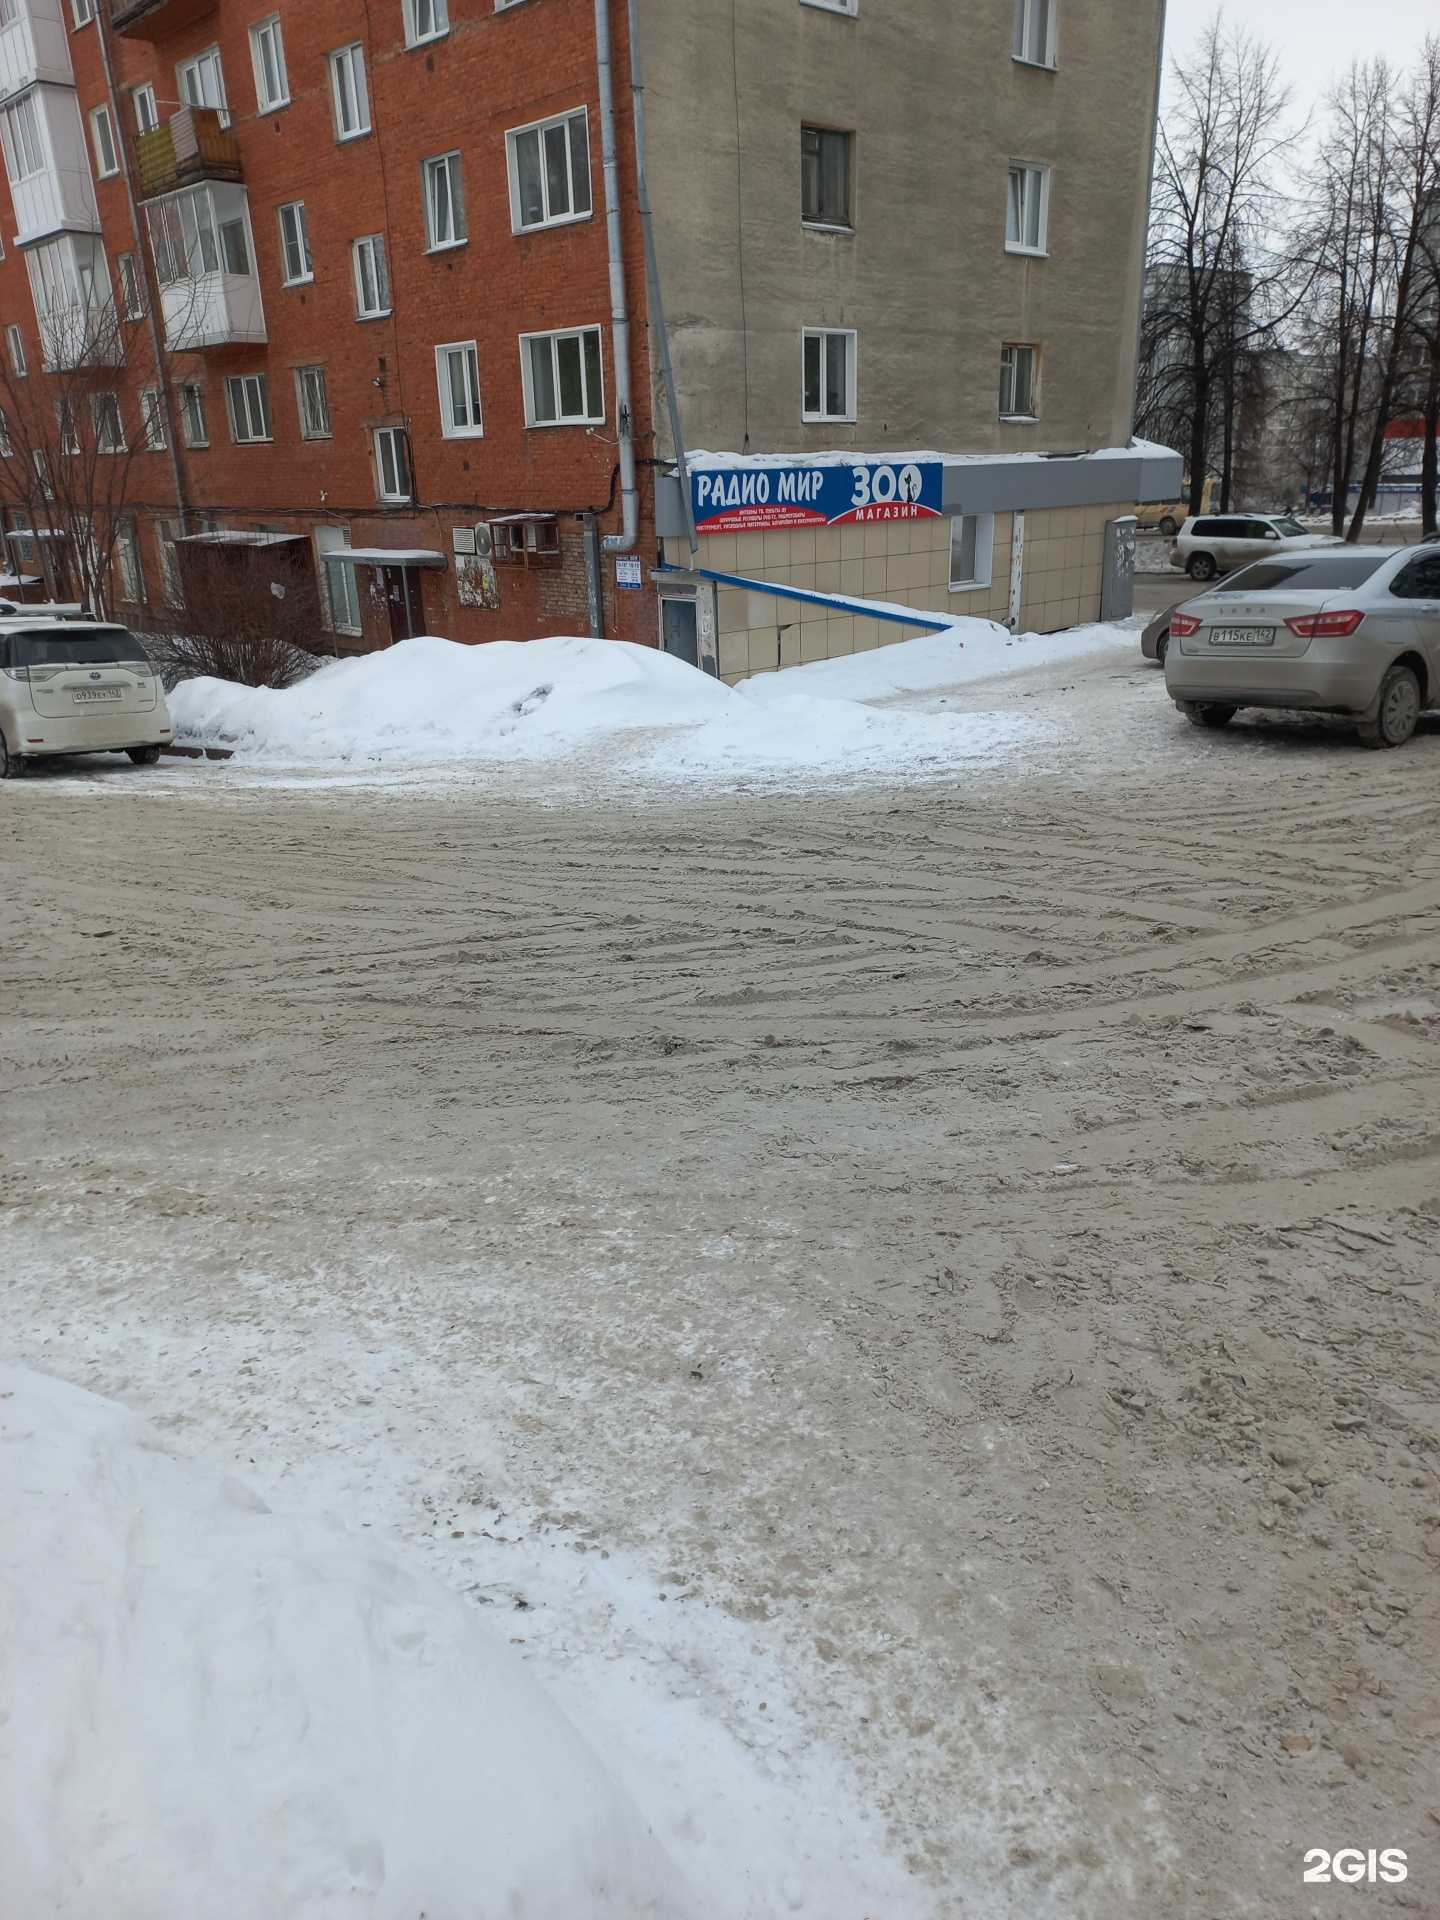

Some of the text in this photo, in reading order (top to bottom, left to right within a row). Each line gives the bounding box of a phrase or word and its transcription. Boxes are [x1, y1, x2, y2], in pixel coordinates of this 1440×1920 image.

[697, 470, 823, 507] РАДИО МИР
[851, 465, 922, 506] ЗОО
[856, 505, 918, 520] МАГАЗИН
